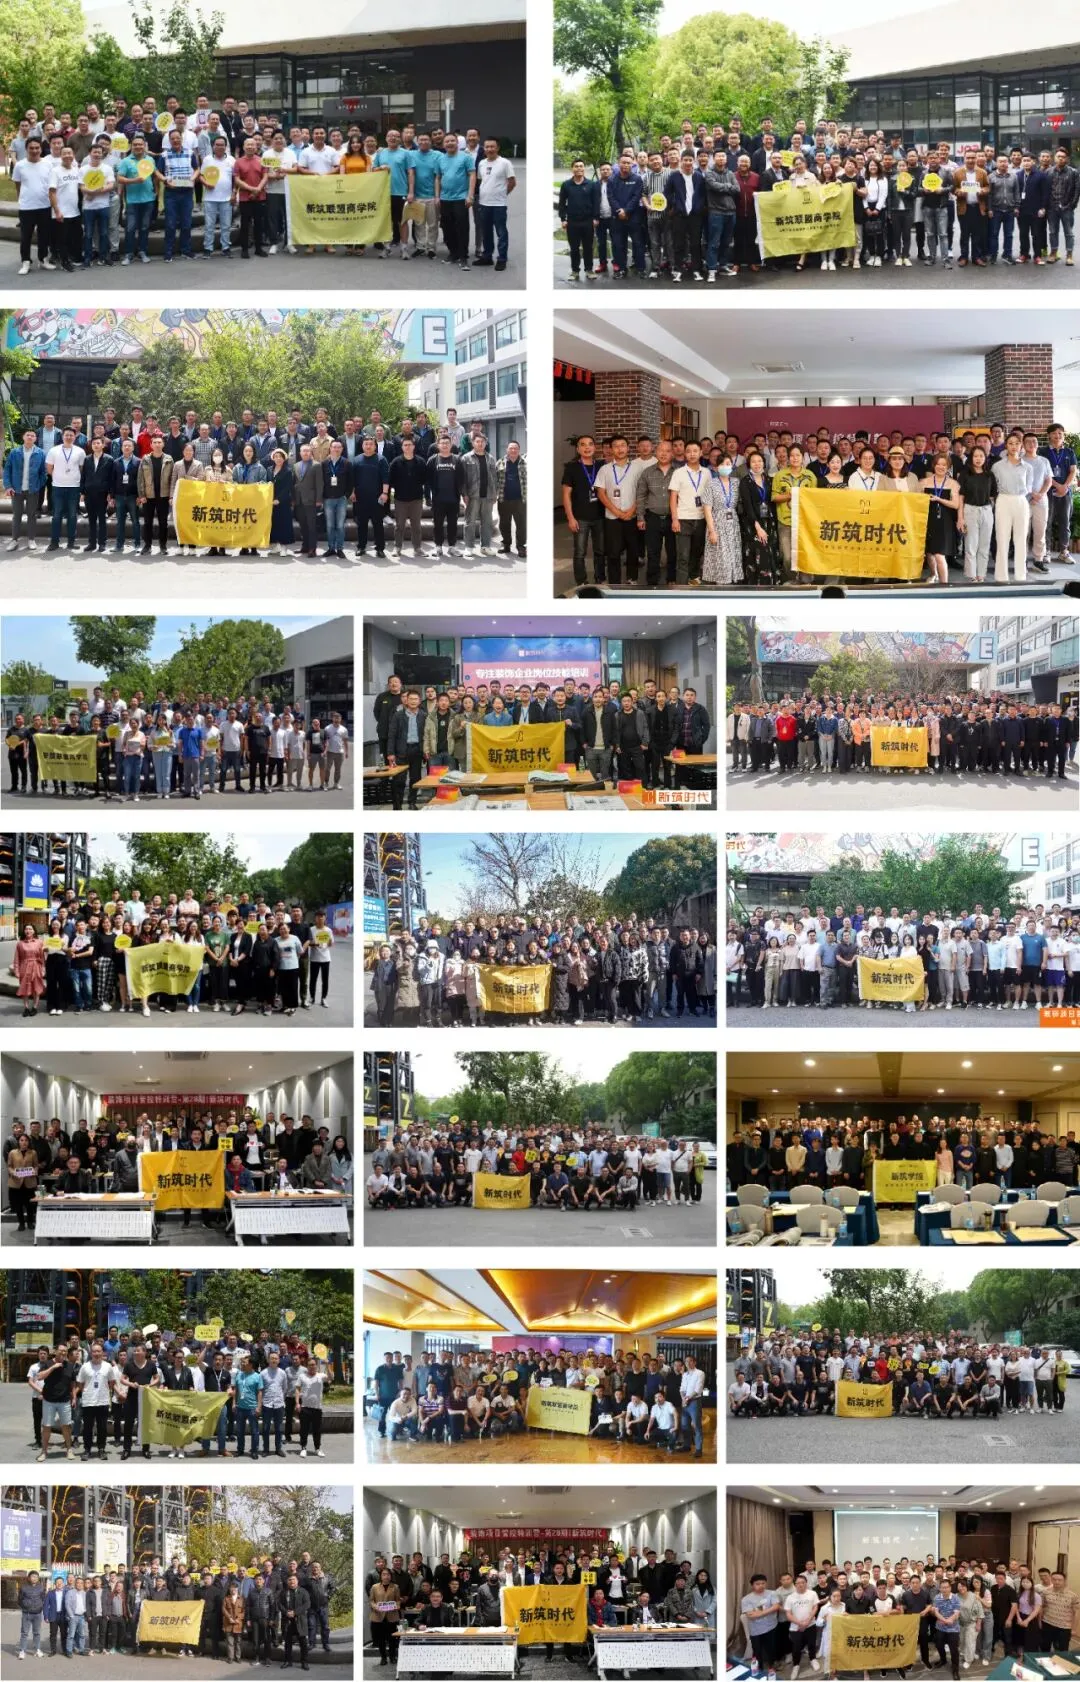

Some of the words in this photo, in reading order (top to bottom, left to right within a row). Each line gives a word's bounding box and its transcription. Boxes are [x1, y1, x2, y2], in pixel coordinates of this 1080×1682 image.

[422, 315, 448, 356] E
[191, 505, 258, 524] 新筑时代
[820, 520, 907, 545] 新筑时代
[881, 740, 919, 753] 新筑时代
[488, 747, 551, 765] 新筑时代
[872, 972, 915, 985] 新筑时代
[492, 982, 540, 996] 新筑时代
[158, 1173, 218, 1189] 新筑时代
[484, 1189, 522, 1200] 新筑时代
[847, 1397, 885, 1408] 新筑时代
[149, 1615, 192, 1626] 新筑时代
[520, 1607, 575, 1624] 新筑时代
[847, 1634, 905, 1649] 新筑时代
